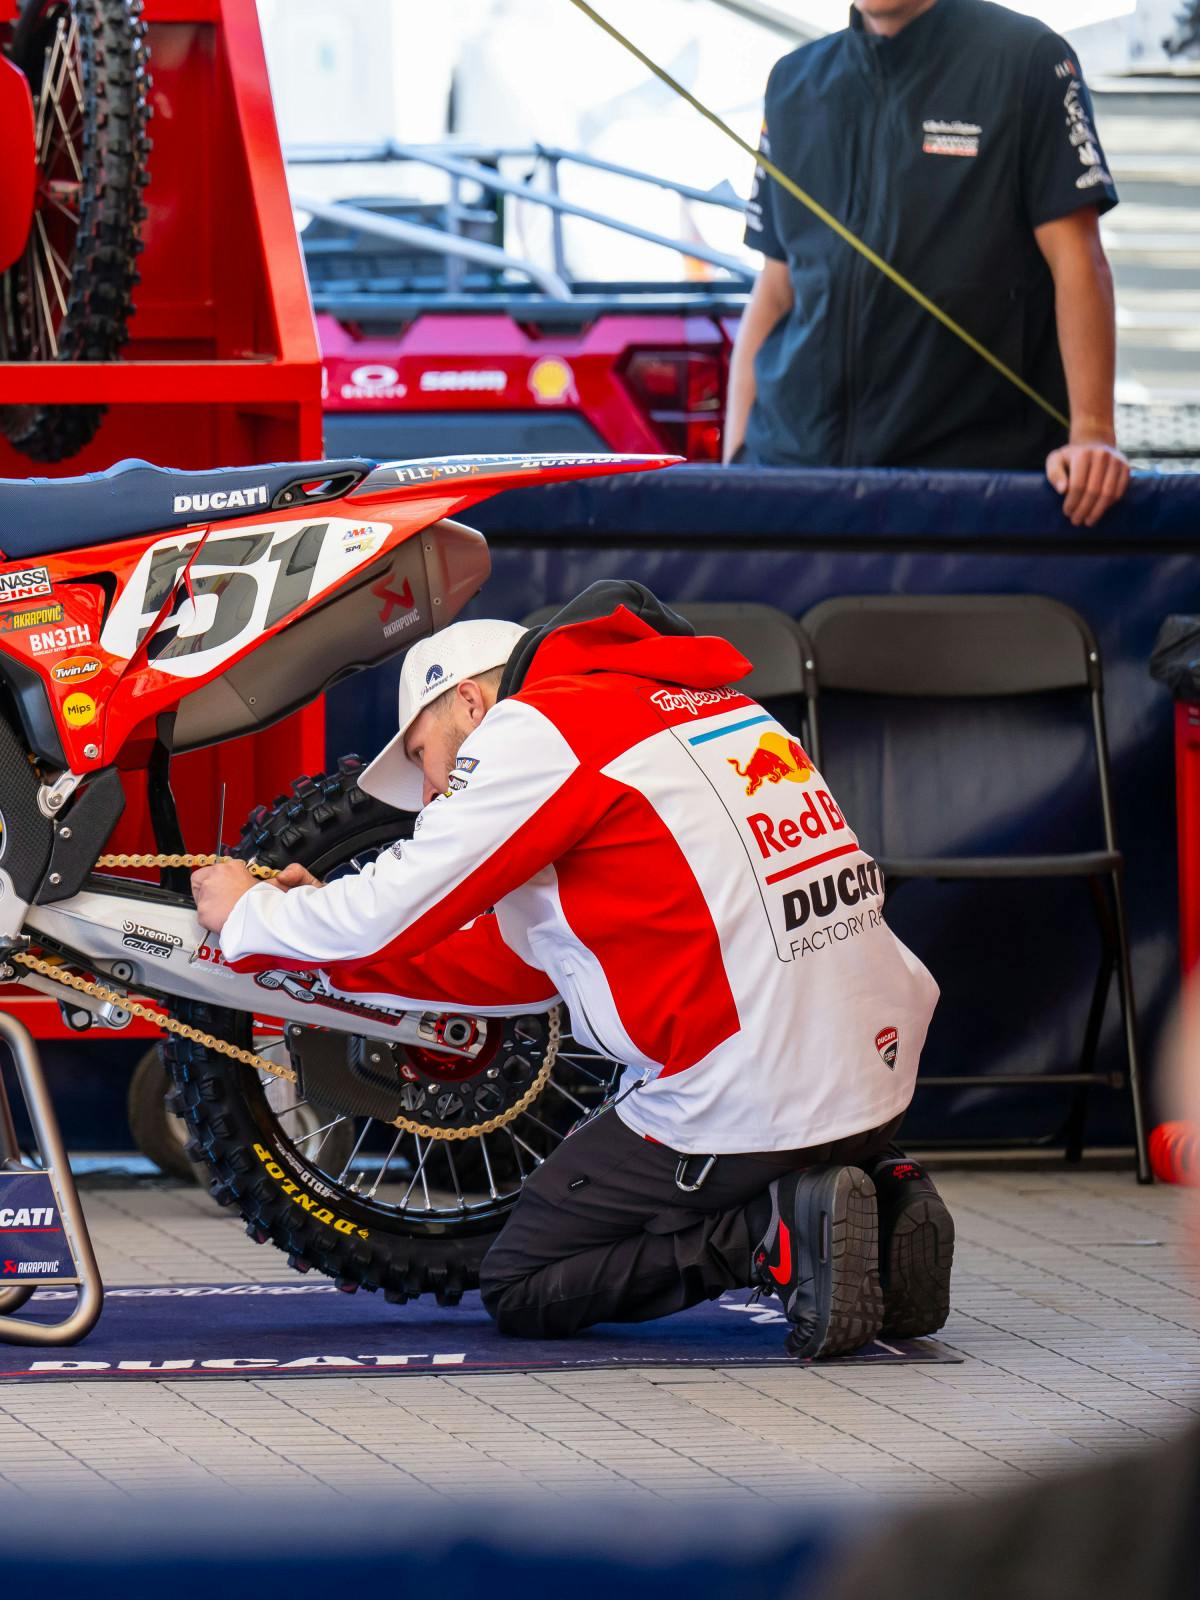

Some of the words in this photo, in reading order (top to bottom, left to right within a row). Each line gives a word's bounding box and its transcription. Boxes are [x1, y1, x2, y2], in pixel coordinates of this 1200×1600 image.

[173, 486, 268, 514] DUCATI
[135, 523, 330, 660] 51
[29, 624, 91, 652] BN3TH
[56, 667, 80, 679] Twin
[82, 662, 99, 673] Air
[68, 704, 91, 715] Mips
[650, 689, 698, 715] Troy
[747, 792, 828, 859] Red
[123, 937, 171, 959] GALFER
[137, 924, 181, 946] brembo
[789, 913, 866, 961] FACTORY
[877, 1031, 896, 1046] DUCATI
[253, 1143, 358, 1236] DUNLOP
[28, 1353, 467, 1372] DUCATI
